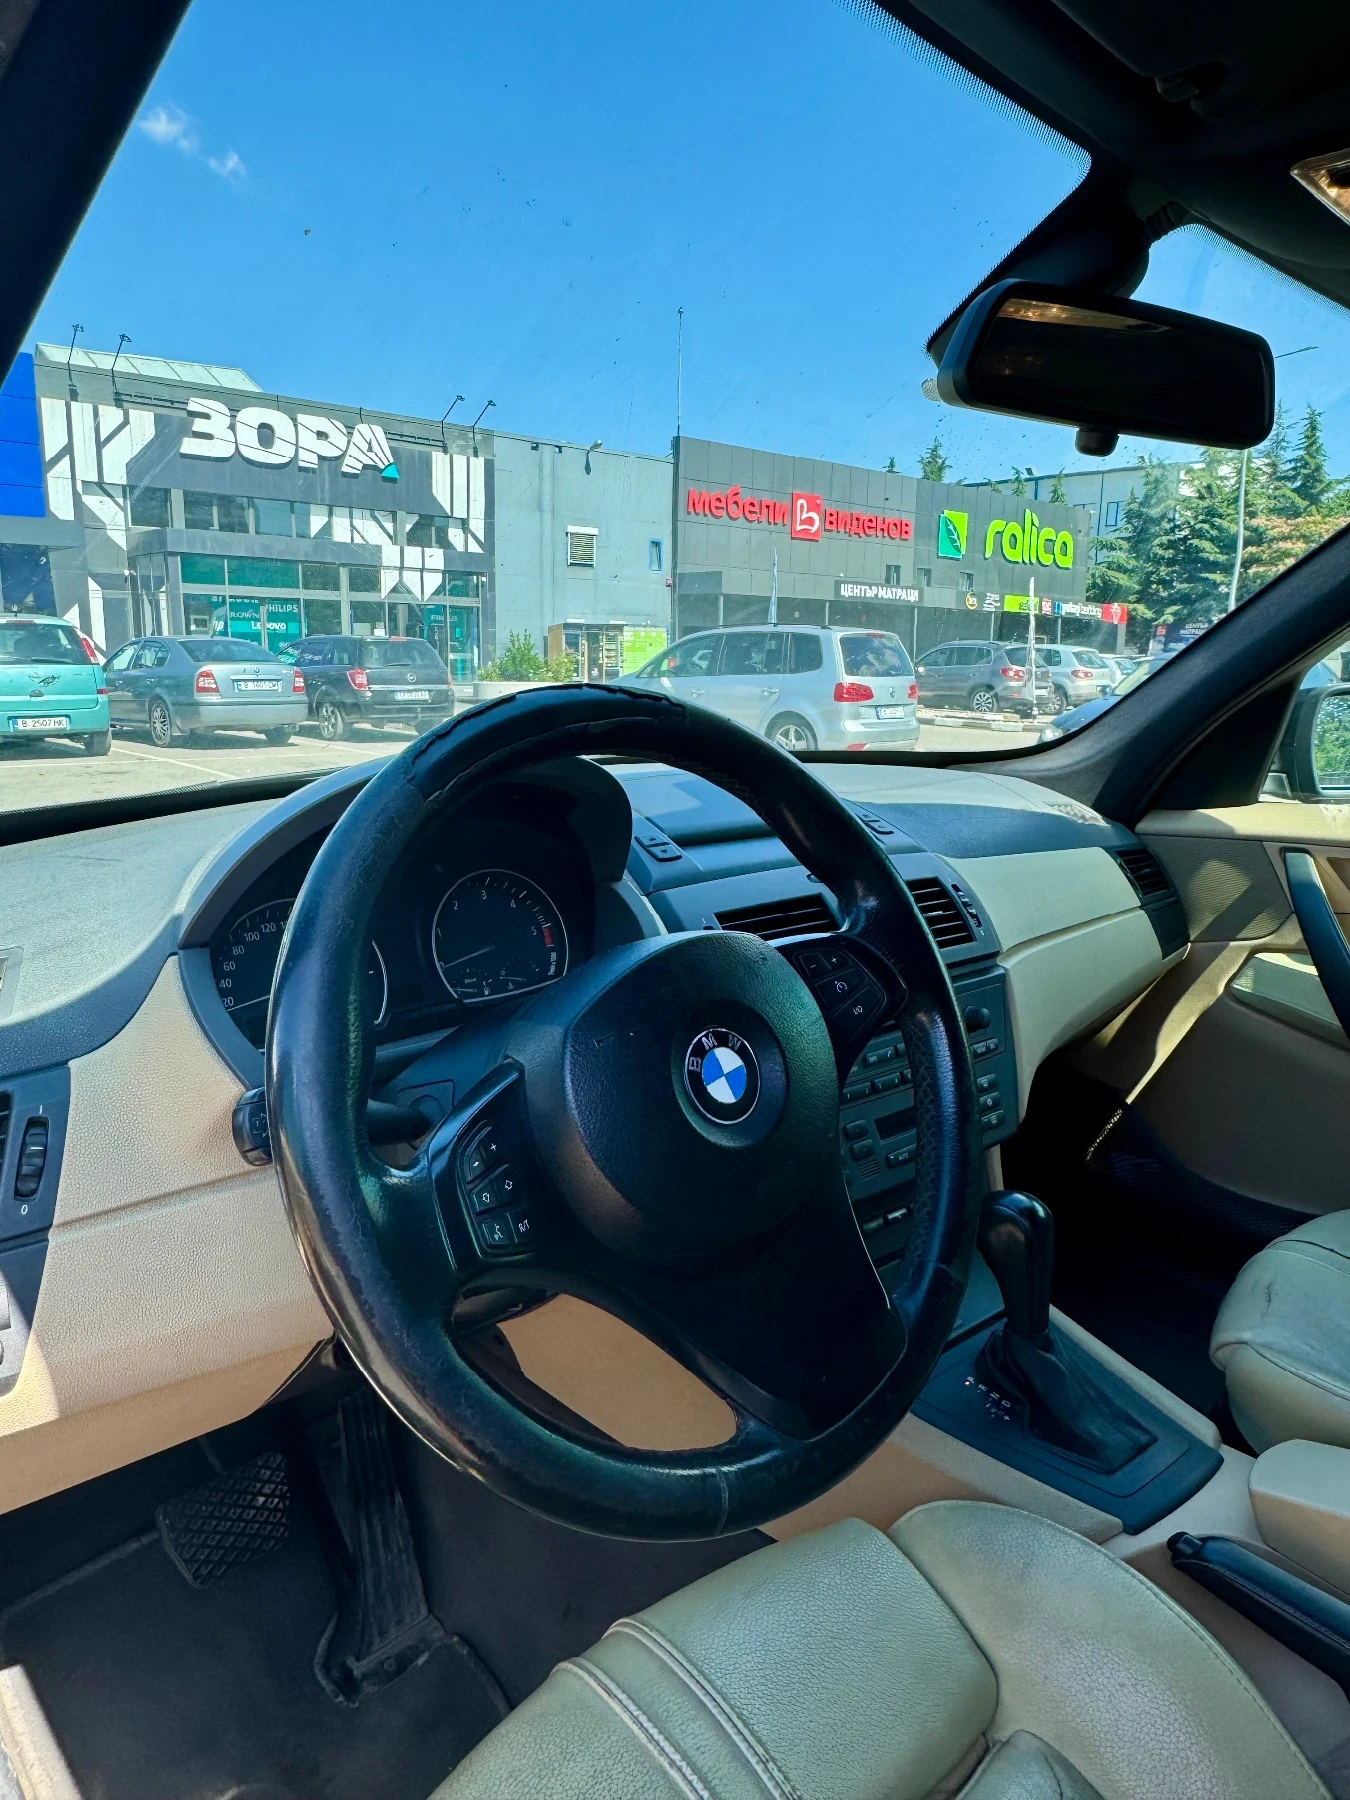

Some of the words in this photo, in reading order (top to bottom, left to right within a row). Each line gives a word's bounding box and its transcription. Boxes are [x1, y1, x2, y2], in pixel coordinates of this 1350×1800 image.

[180, 397, 400, 483] ЗОРА
[687, 485, 788, 526] мебели
[824, 508, 912, 540] виденов
[985, 508, 1074, 569] ralica
[840, 583, 877, 598] ЦЕНТЪР
[878, 586, 919, 602] МАТРАЦИ
[260, 922, 277, 933] 120
[243, 931, 260, 942] 100
[232, 945, 245, 956] 80
[223, 961, 236, 972] 60
[219, 978, 232, 989] 40
[688, 1032, 742, 1073] BMW
